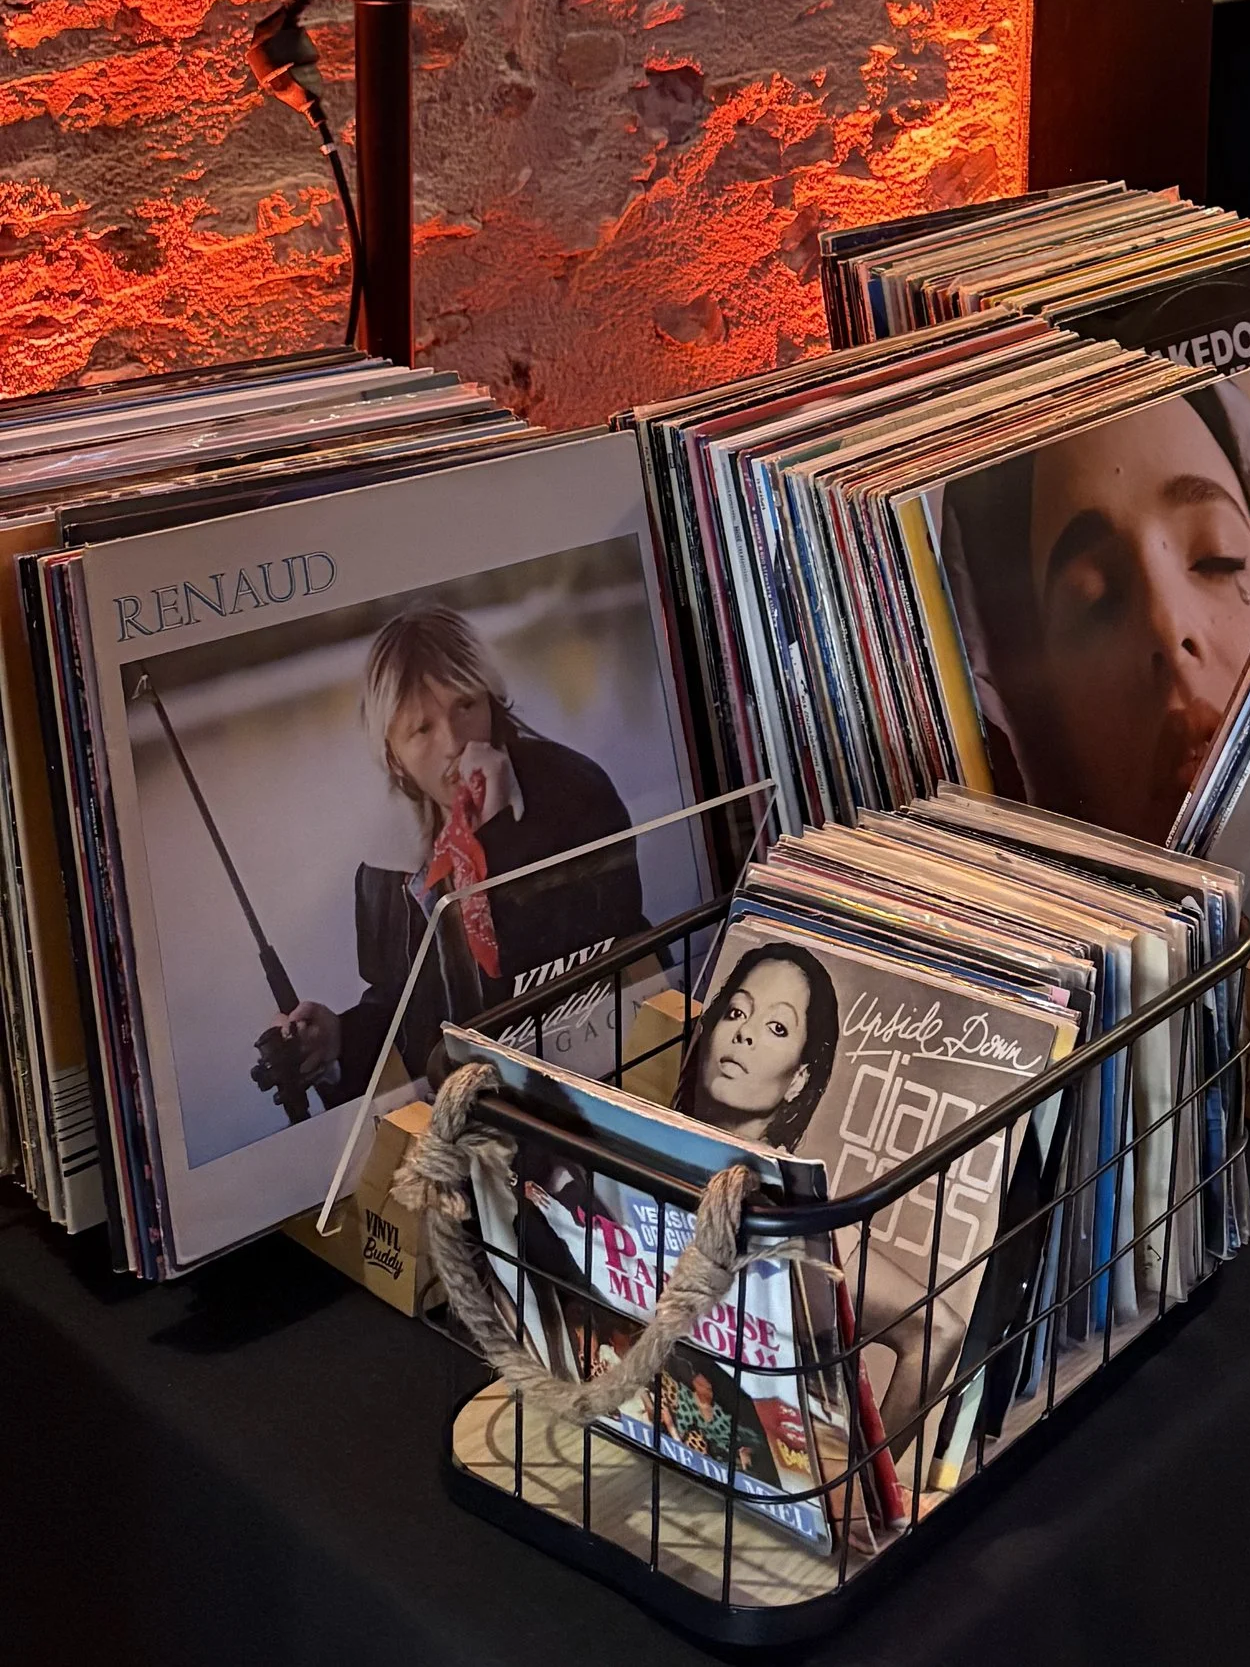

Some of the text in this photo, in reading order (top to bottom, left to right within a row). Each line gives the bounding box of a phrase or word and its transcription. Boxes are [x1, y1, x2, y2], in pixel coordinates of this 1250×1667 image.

[113, 550, 338, 643] RENAUD
[842, 991, 1042, 1070] Upside Down
[366, 1208, 401, 1253] VINYL
[363, 1236, 404, 1280] Buddy
[608, 1268, 649, 1311] MI
[744, 1479, 812, 1536] MIEL
